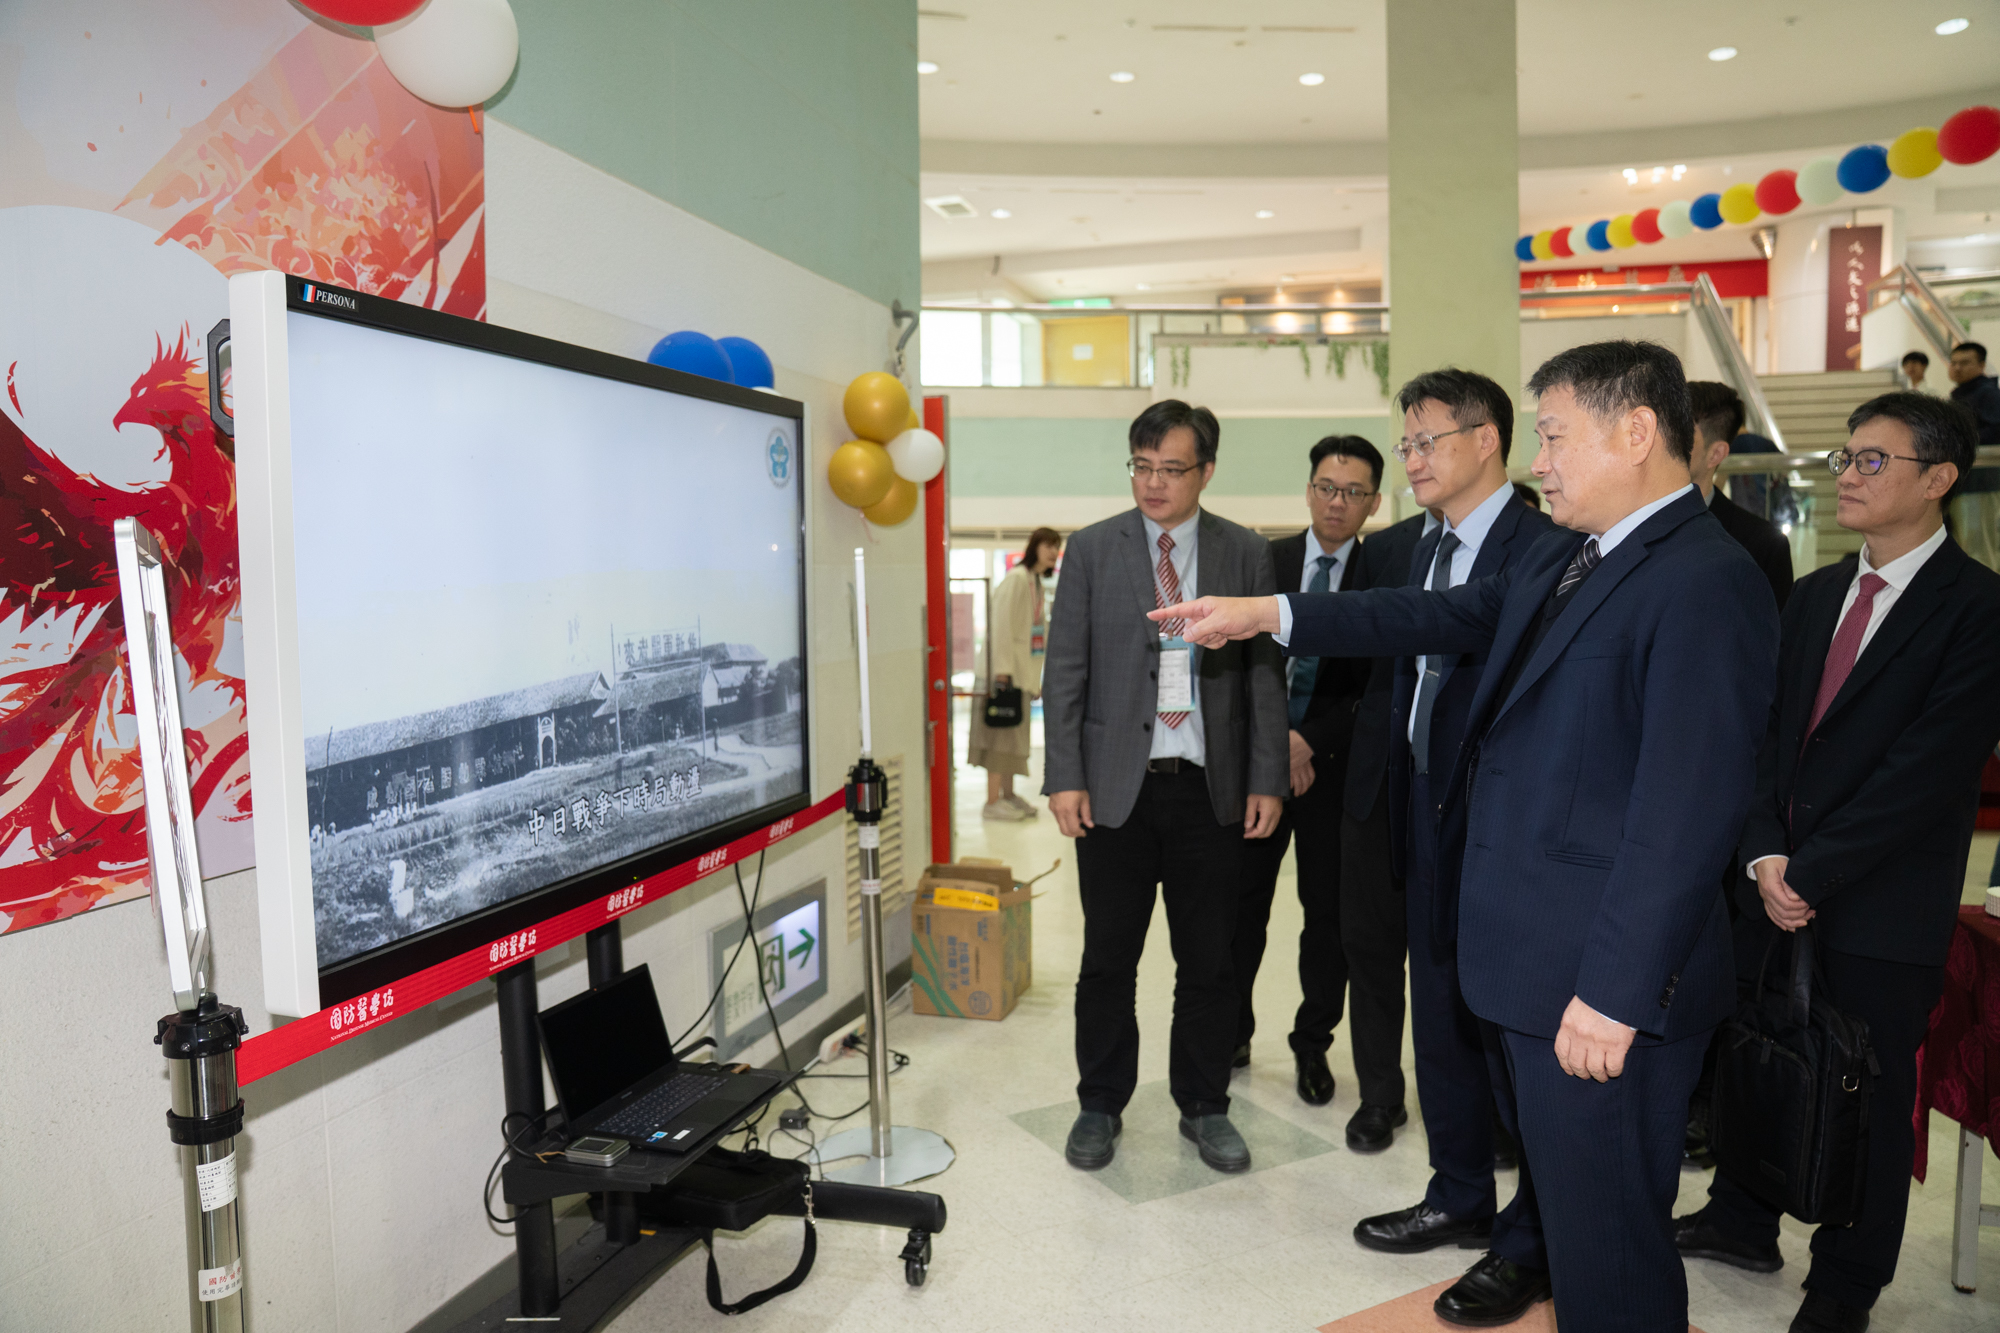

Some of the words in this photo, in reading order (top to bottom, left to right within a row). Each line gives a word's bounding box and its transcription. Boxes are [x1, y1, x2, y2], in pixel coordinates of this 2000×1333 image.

[316, 290, 356, 309] PERSONA
[528, 766, 702, 846] 中日戰爭下時局動盪
